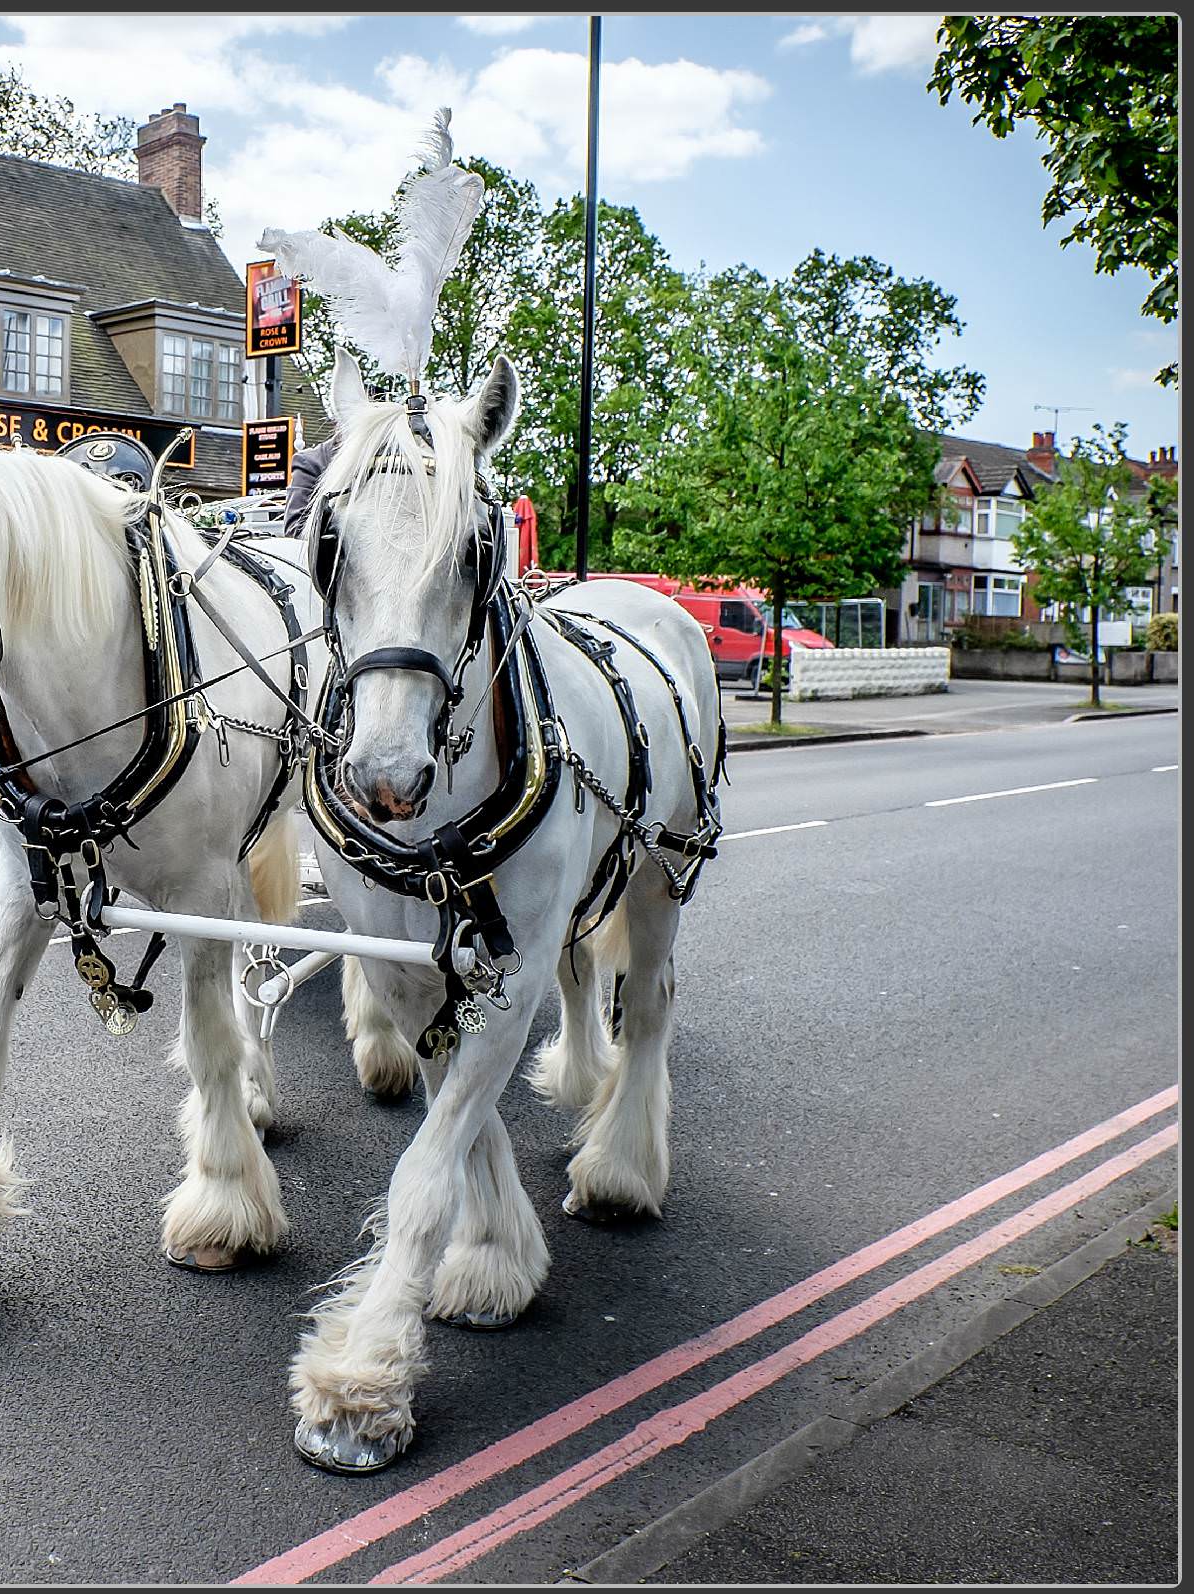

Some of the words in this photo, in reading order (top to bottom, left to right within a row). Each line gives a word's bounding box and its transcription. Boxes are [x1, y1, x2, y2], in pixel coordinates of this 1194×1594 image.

[260, 326, 279, 337] ROSE
[281, 325, 287, 335] &
[259, 336, 288, 348] CROWN
[32, 418, 49, 442] &
